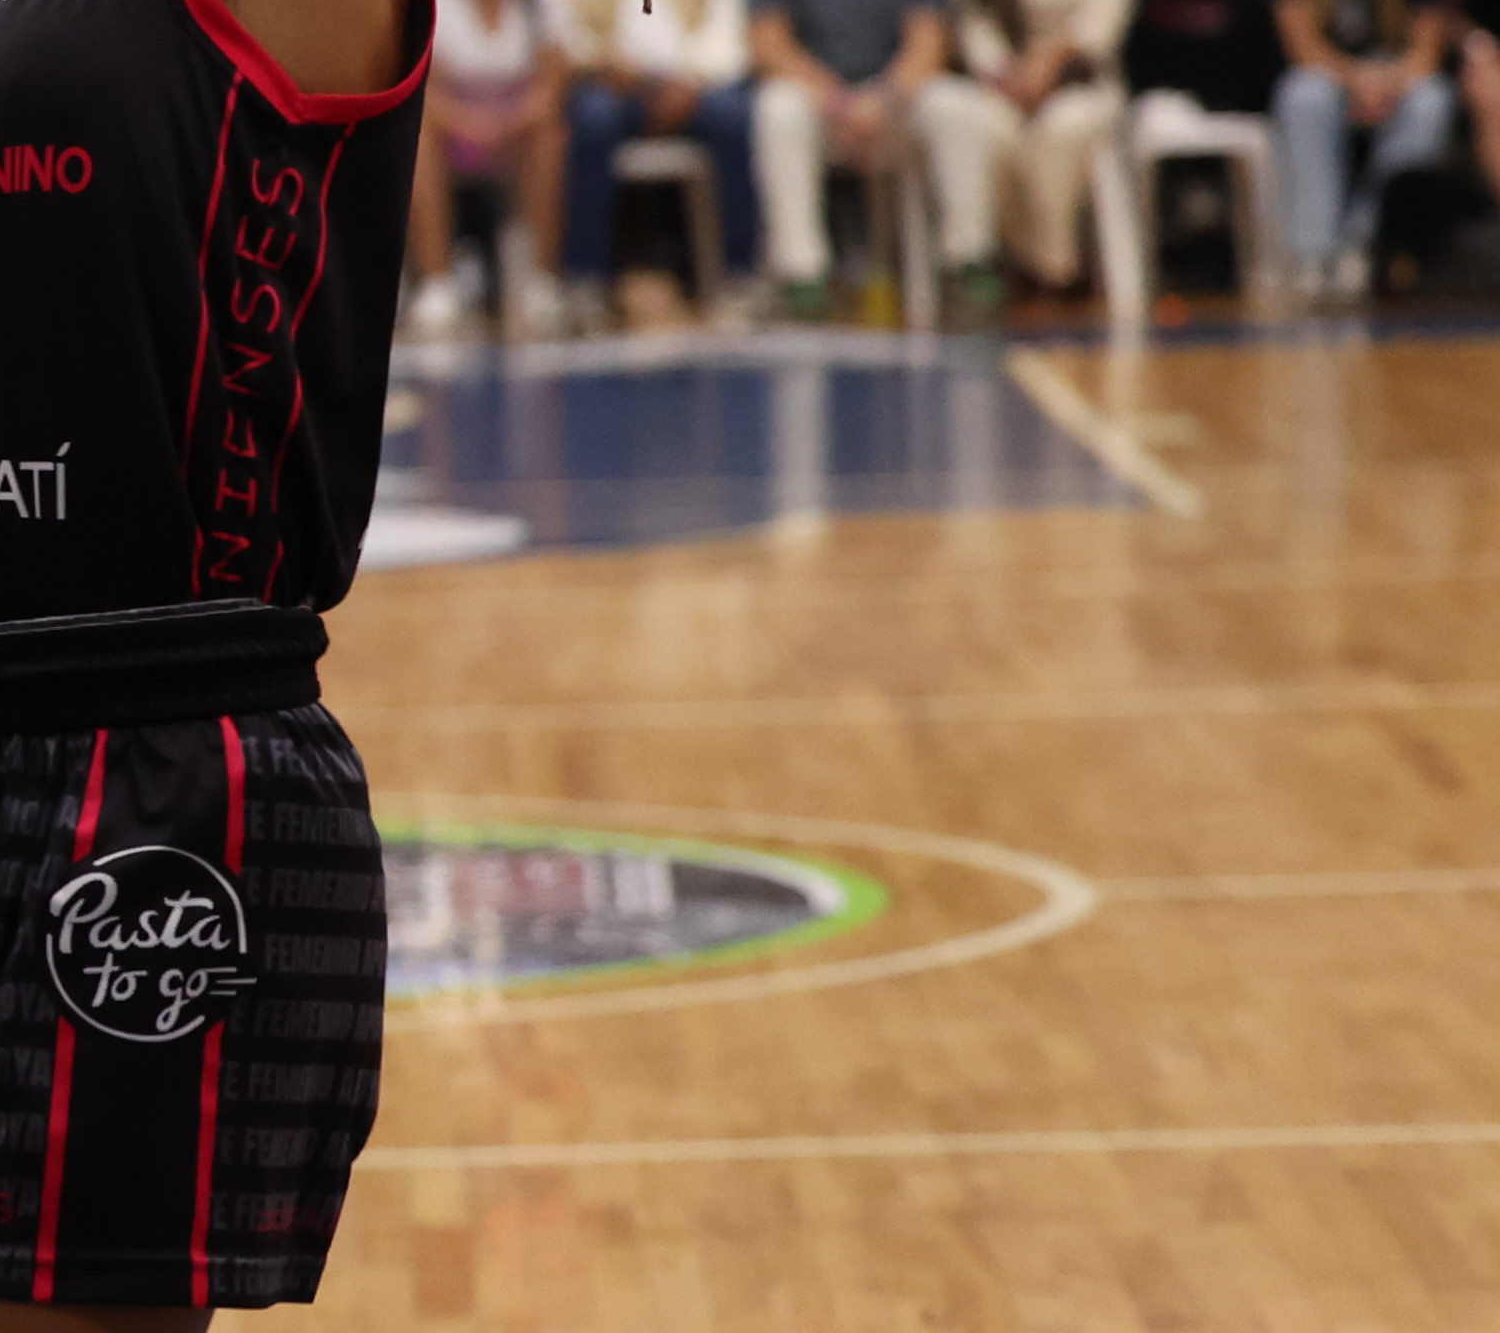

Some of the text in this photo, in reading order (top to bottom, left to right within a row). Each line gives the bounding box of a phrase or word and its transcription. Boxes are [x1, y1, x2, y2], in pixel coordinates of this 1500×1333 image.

[50, 871, 233, 955] Pasta
[83, 962, 209, 1031] to go
